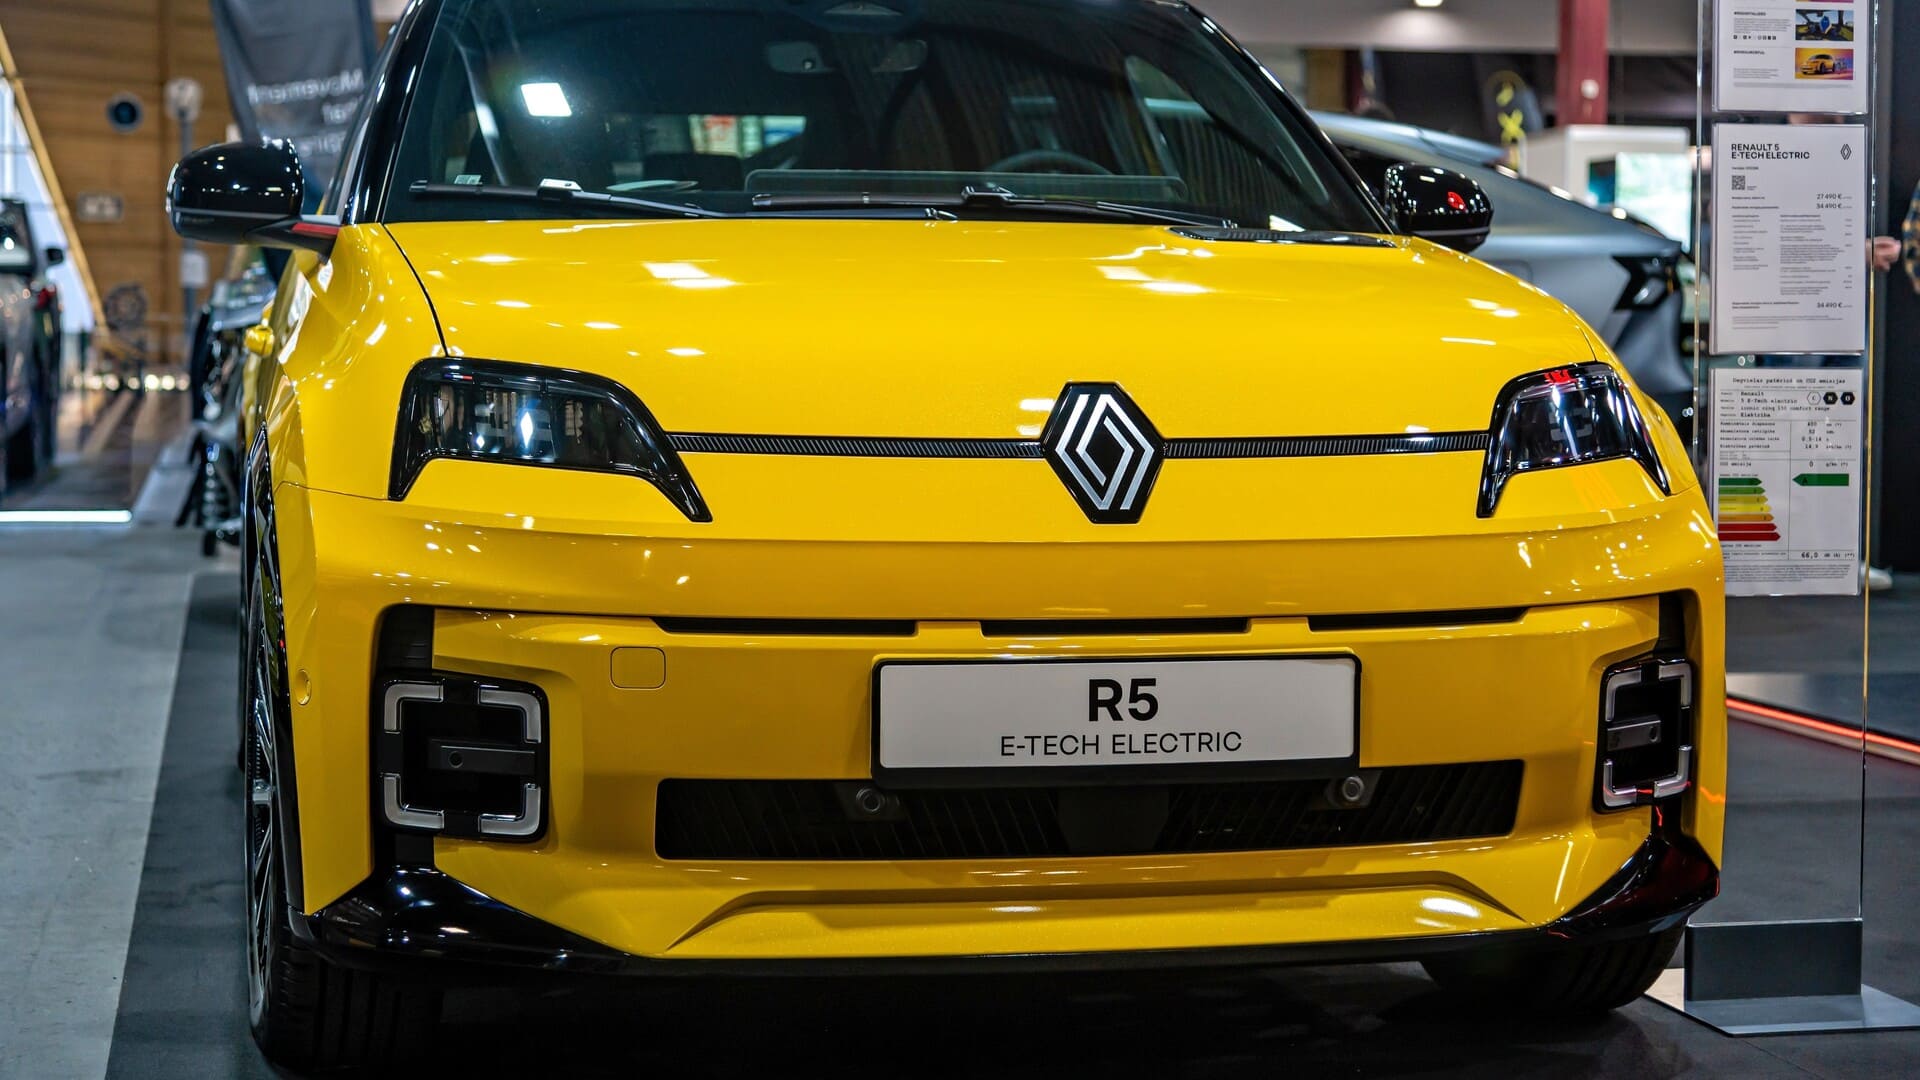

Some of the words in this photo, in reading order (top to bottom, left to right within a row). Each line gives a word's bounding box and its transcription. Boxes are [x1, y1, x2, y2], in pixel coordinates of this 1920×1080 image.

[1731, 143, 1773, 151] RENAULT
[1774, 143, 1780, 151] 5
[1731, 151, 1765, 159] E-TECH
[1765, 151, 1810, 160] ELECTRIC
[1087, 677, 1160, 722] R5
[1000, 734, 1100, 757] E-TECH
[1112, 731, 1242, 755] ELECTRIC
